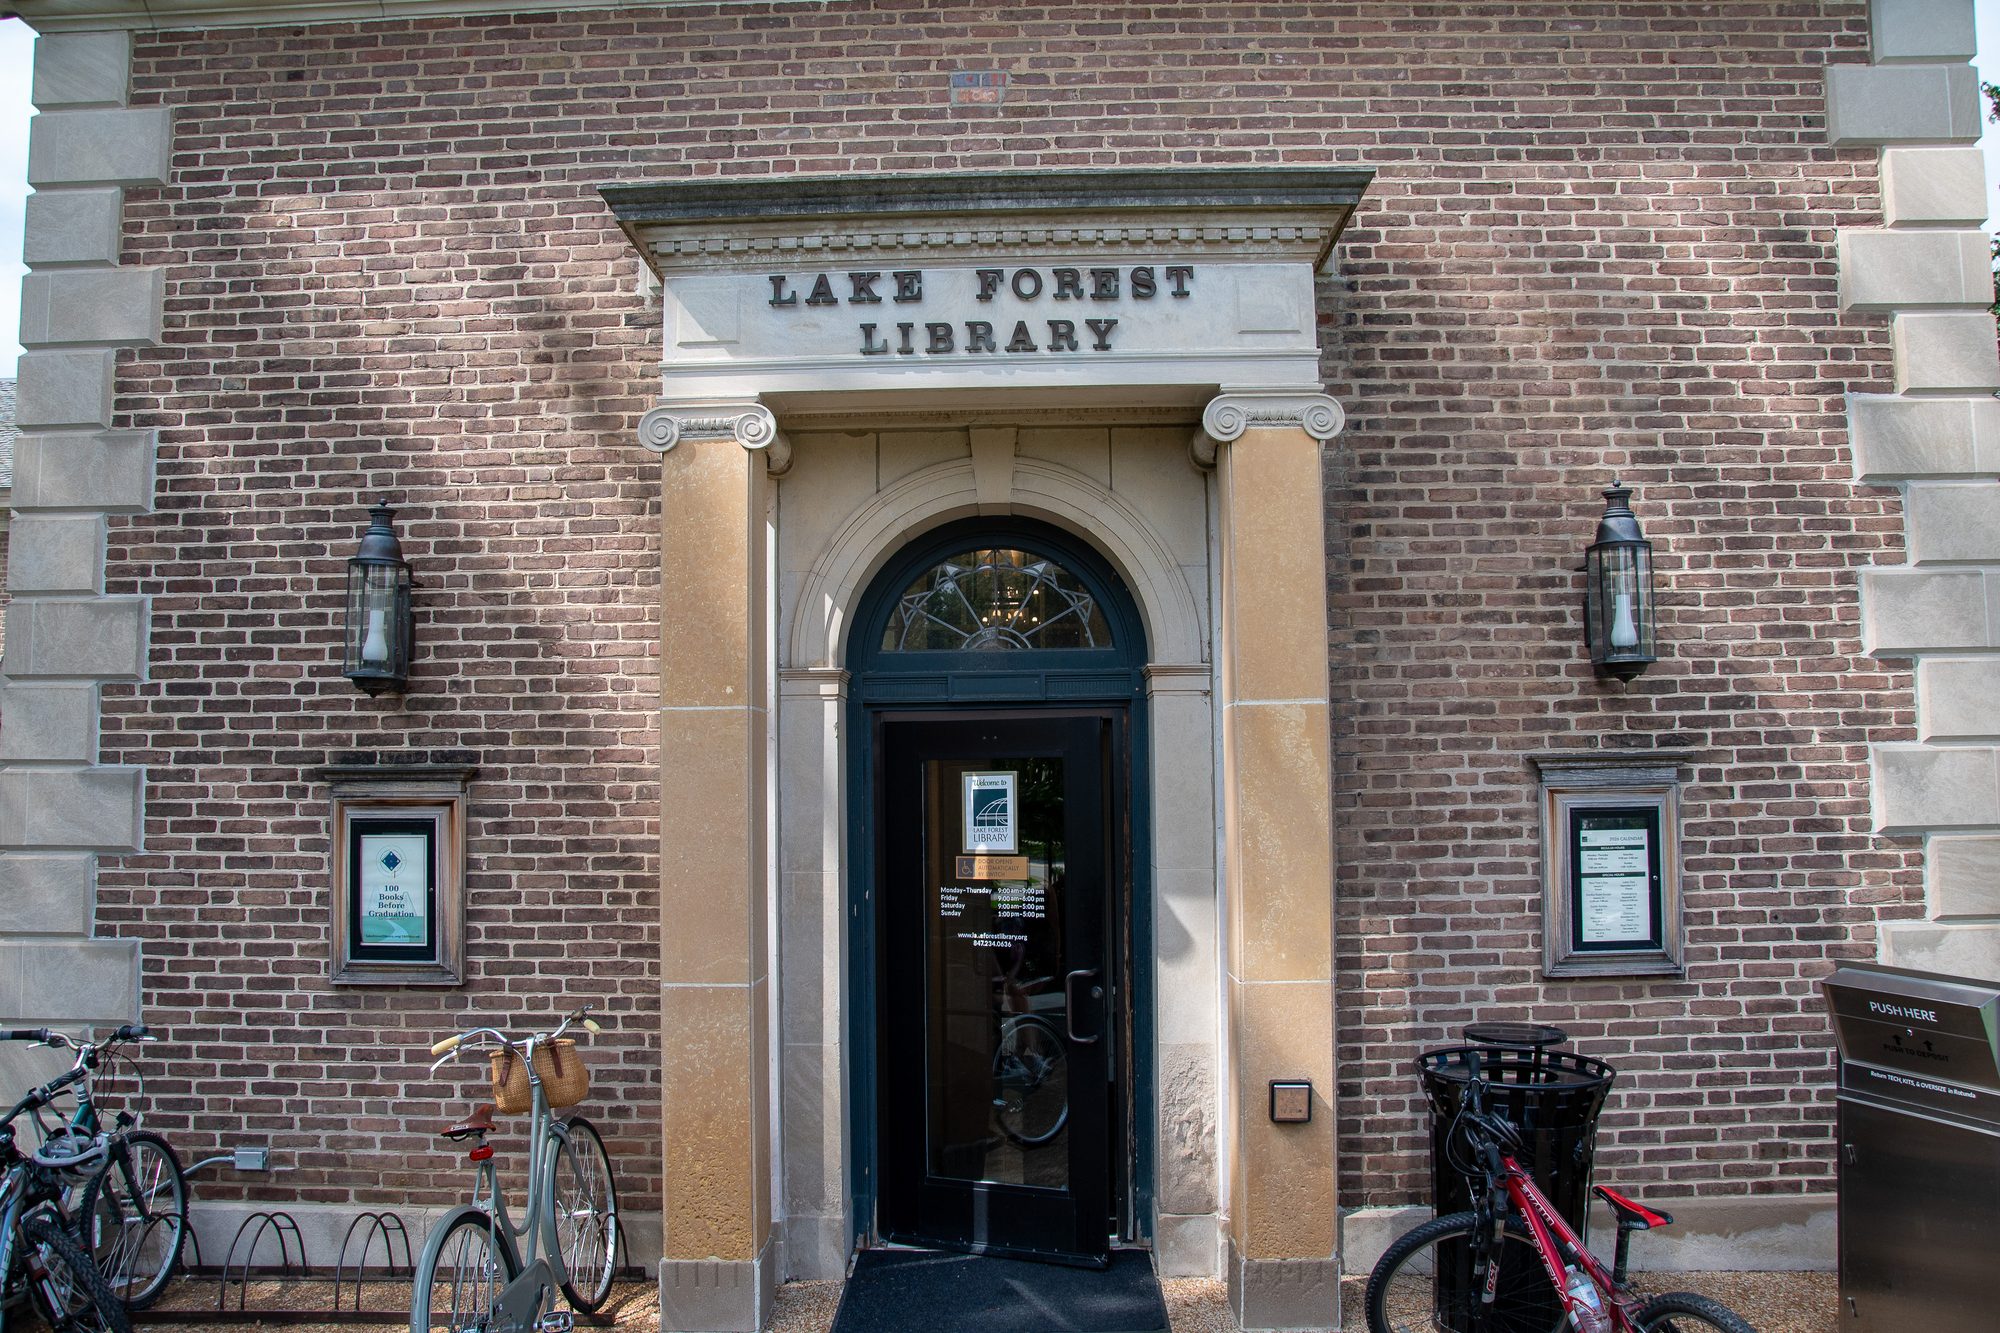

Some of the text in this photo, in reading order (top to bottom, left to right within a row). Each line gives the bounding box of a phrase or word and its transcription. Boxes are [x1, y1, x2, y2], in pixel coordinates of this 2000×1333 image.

[768, 266, 1194, 305] LAKE FOREST
[859, 318, 1119, 354] LIBRARY
[973, 834, 1008, 842] LIBRARY
[368, 910, 415, 918] Graduation
[940, 902, 966, 910] Saturday
[957, 932, 1028, 941] www.laeforestlibrary.org
[973, 940, 1012, 948] 847.234.0636
[1869, 1001, 1938, 1023] PUSH HERE
[1883, 1043, 1949, 1062] PUSH TO DEPOSIT
[1870, 1070, 1887, 1080] Return
[1887, 1074, 1903, 1085] TECH,
[1902, 1078, 1916, 1087] KITS,
[1921, 1082, 1947, 1093] OVERSIZE
[1953, 1089, 1977, 1099] Rotunda
[1486, 1261, 1497, 1292] RST
